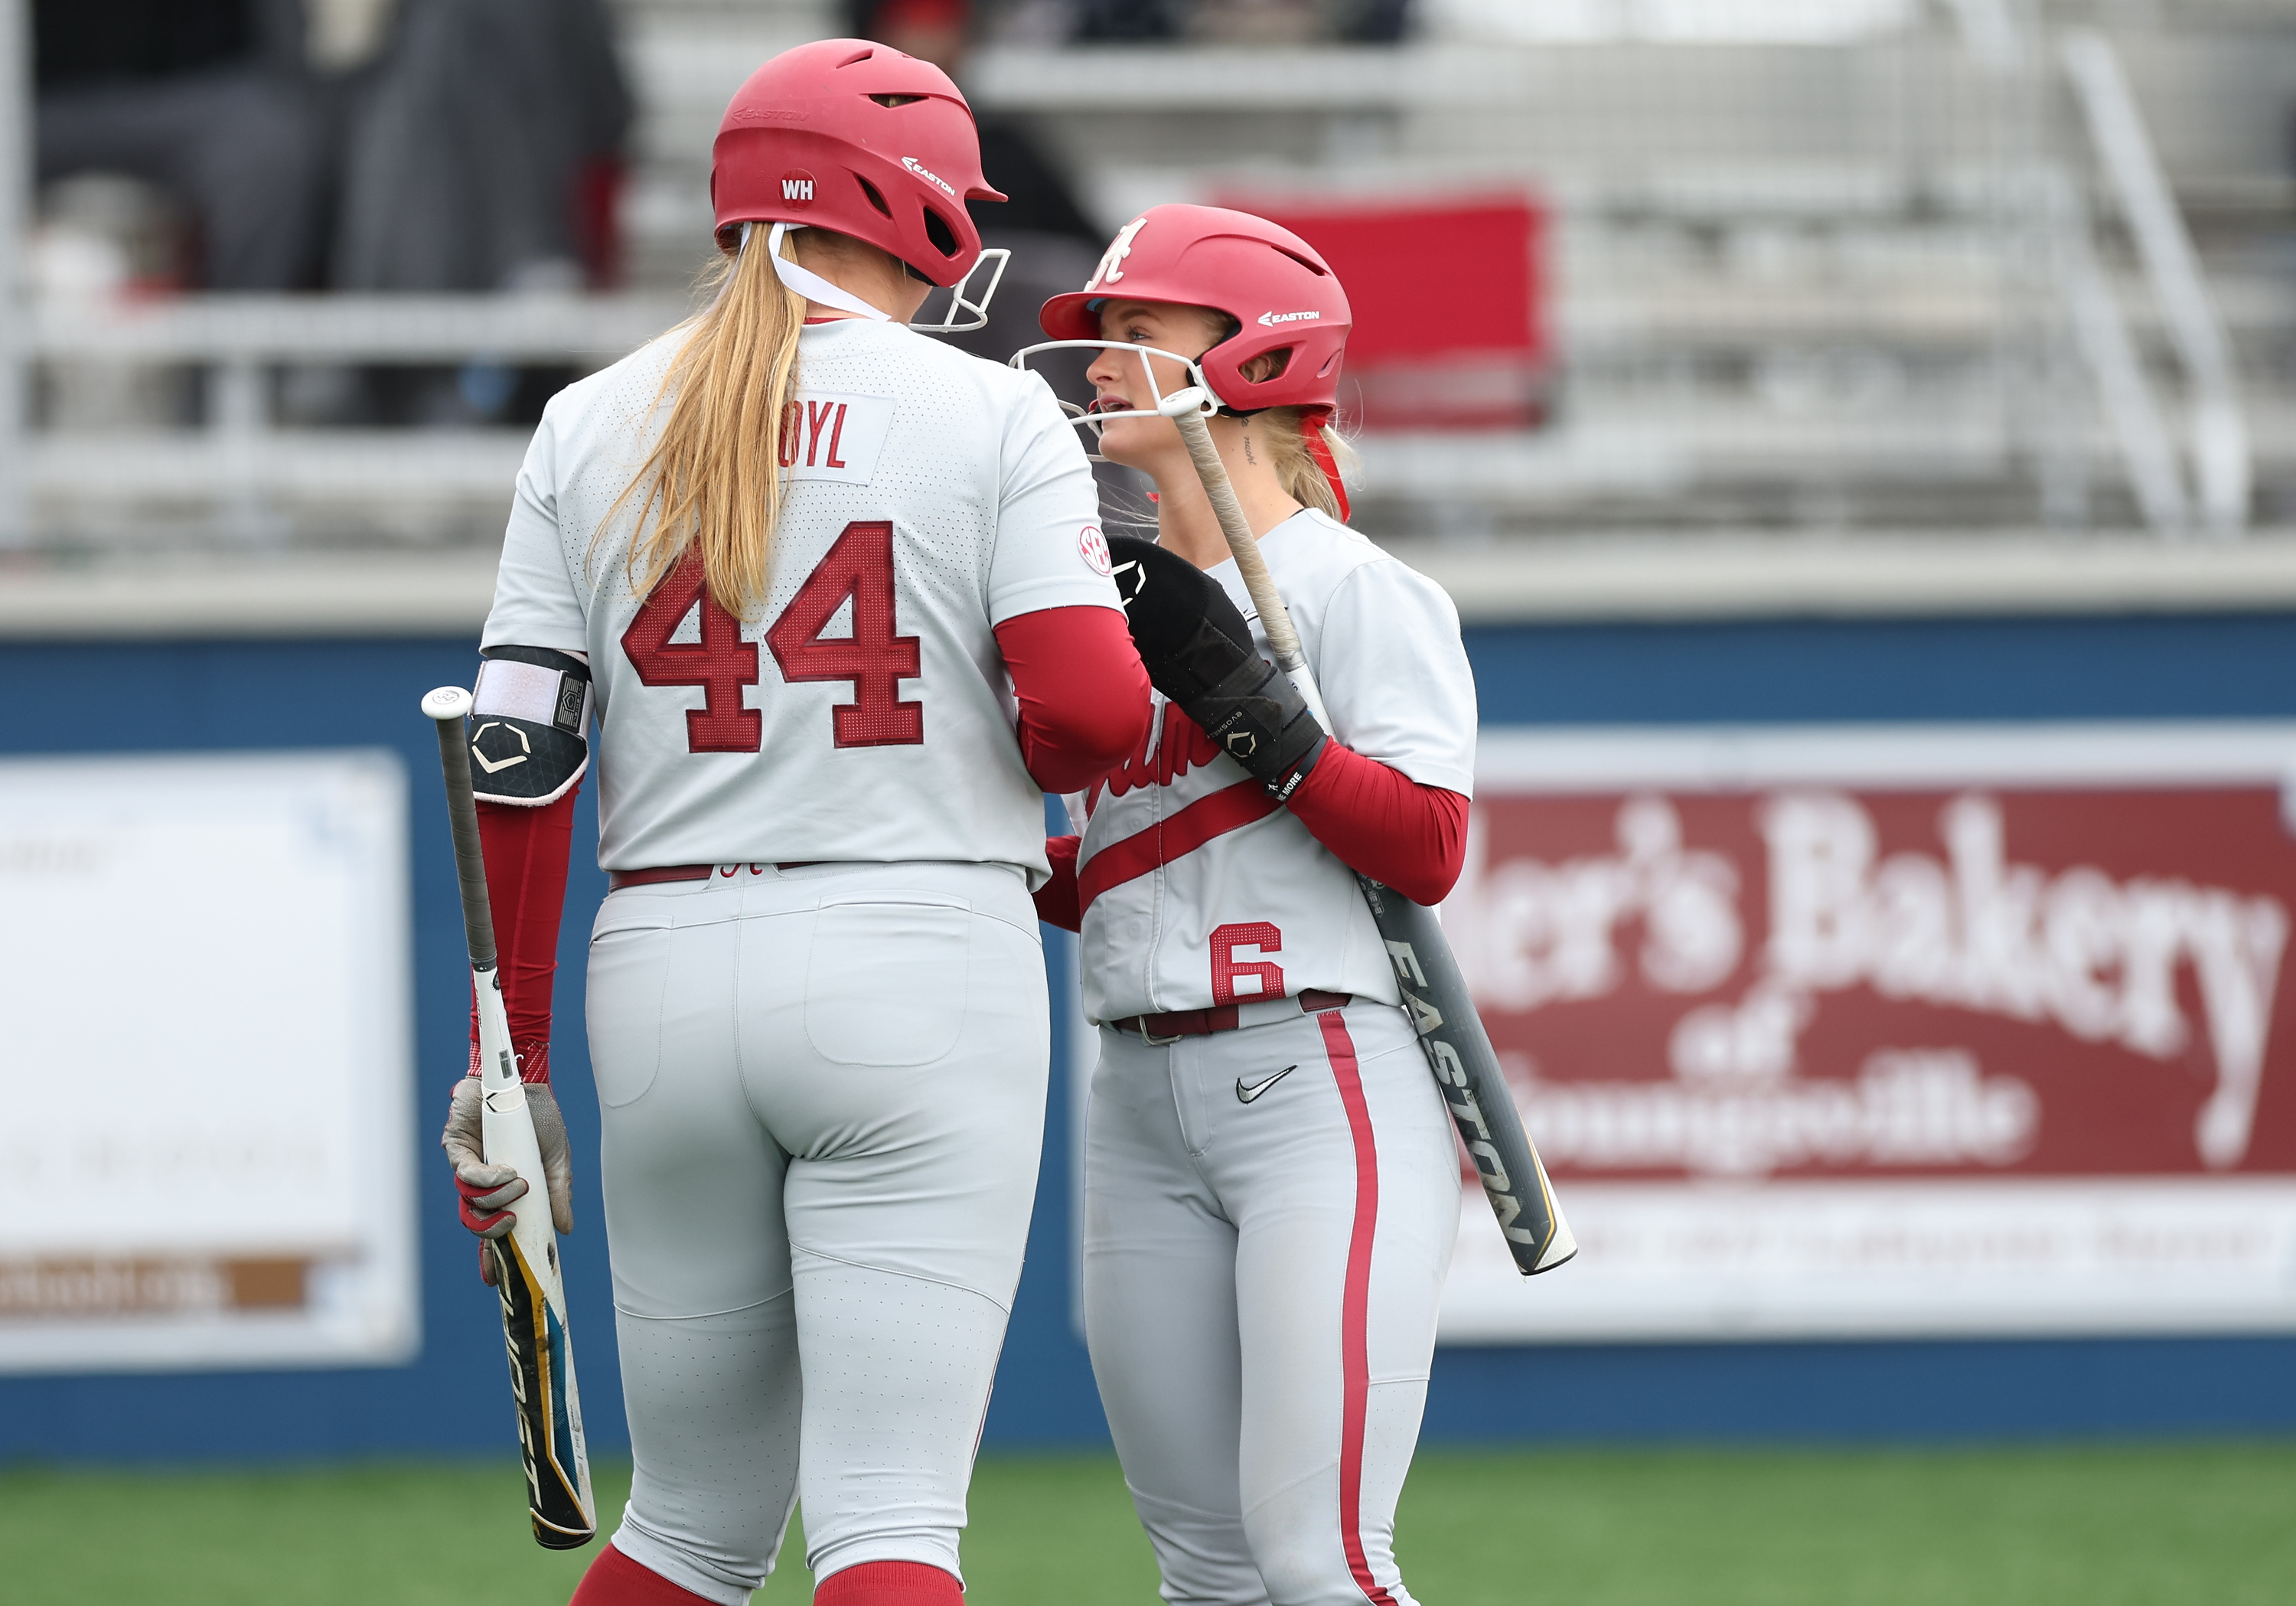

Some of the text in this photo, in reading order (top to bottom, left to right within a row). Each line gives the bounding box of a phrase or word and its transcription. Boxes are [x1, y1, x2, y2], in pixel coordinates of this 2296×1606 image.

[742, 109, 810, 122] EASTON
[781, 179, 813, 200] WH
[912, 163, 956, 196] EASTON
[1272, 311, 1320, 324] EASTON
[778, 400, 847, 468] OYL
[1080, 527, 1110, 574] SEC
[621, 521, 925, 753] 44
[1282, 772, 1303, 795] MORE
[1209, 921, 1287, 1007] 6
[1443, 791, 2288, 1173] ler's Bakery
[1384, 938, 1535, 1245] EASTON
